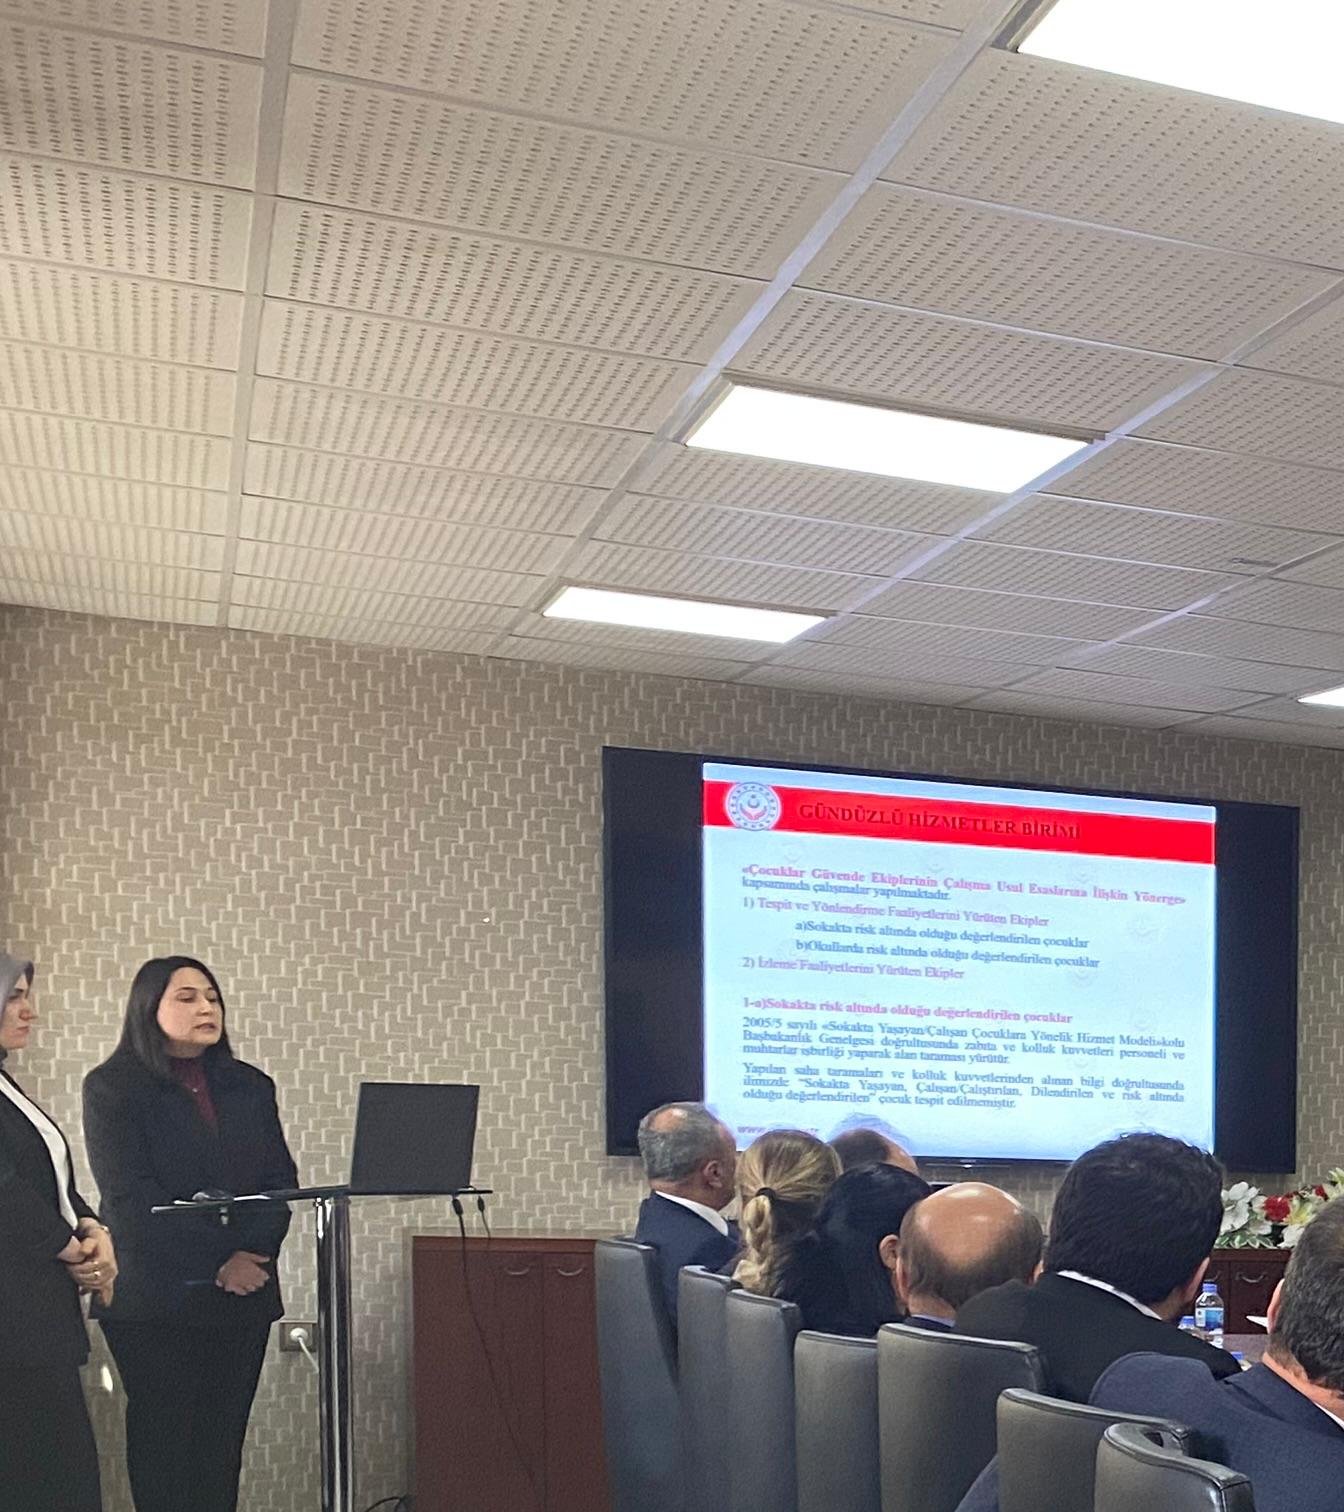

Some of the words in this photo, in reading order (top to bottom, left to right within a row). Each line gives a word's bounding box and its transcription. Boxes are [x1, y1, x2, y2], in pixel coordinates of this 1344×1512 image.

[800, 803, 904, 826] GÜNDÜZLÜ
[909, 809, 1016, 834] HİZMETLER
[1023, 818, 1080, 840] BİRİMİ
[742, 878, 810, 893] kapsamında
[813, 882, 870, 897] çalışmalar
[811, 869, 864, 882] Güvende
[871, 872, 937, 890] Ekiplerinin
[943, 877, 991, 893] Çalışma
[997, 880, 1022, 892] Usul
[1029, 882, 1087, 896] Esaslarına
[1093, 886, 1127, 901] İlişkin
[744, 897, 754, 911] 1)
[757, 898, 792, 913] Tespit
[796, 902, 808, 911] ve
[812, 901, 884, 916] Yönlendirme
[964, 910, 1006, 923] Yürüten
[1010, 913, 1049, 927] Ekipler
[855, 923, 876, 935] risk
[879, 925, 916, 937] altında
[919, 927, 958, 942] olduğu
[960, 929, 1040, 946] değerlendirilen
[1043, 934, 1089, 949] çocuklar
[742, 956, 754, 970] 2)
[758, 957, 796, 970] İzleme
[877, 963, 921, 976] Yürüten
[925, 966, 964, 980] Ekipler
[866, 944, 887, 955] risk
[890, 945, 927, 957] altında
[930, 947, 968, 962] olduğu
[971, 949, 1051, 966] değerlendirilen
[1054, 954, 1099, 969] çocuklar
[820, 1001, 842, 1012] risk
[846, 1002, 886, 1014] altında
[890, 1004, 930, 1018] olduğu
[934, 1006, 1020, 1022] değerlendirilen
[1023, 1010, 1072, 1025] çocuklar
[743, 1018, 781, 1032] 2005/5
[787, 1019, 816, 1033] sayılı
[971, 1028, 1025, 1042] Çocuklara
[1032, 1030, 1072, 1042] Yönelik
[1077, 1032, 1114, 1043] Hizmet
[743, 1030, 811, 1045] Başbakanlık
[819, 1034, 874, 1048] Genelgesi
[881, 1036, 958, 1051] doğrultusunda
[965, 1040, 996, 1050] zabıta
[1003, 1043, 1015, 1051] ve
[1022, 1042, 1054, 1053] kolluk
[1062, 1044, 1113, 1055] kuvvetleri
[1119, 1046, 1165, 1060] personeli
[1173, 1050, 1184, 1058] ve
[847, 1048, 892, 1061] yaparak
[894, 1050, 917, 1059] alan
[920, 1051, 965, 1061] taraması
[744, 1063, 786, 1077] Yapılan
[794, 1065, 819, 1075] saha
[827, 1066, 883, 1078] taramaları
[891, 1070, 903, 1078] ve
[912, 1070, 946, 1080] kolluk
[955, 1071, 1033, 1083] kuvvetlerinden
[1041, 1075, 1072, 1085] alınan
[1080, 1076, 1103, 1088] bilgi
[1111, 1077, 1183, 1091] doğrultusunda
[742, 1089, 782, 1102] olduğu
[878, 1094, 911, 1106] çocuk
[915, 1095, 943, 1107] tespit
[1031, 1087, 1093, 1098] Dilendirilen
[1102, 1090, 1114, 1099] ve
[1122, 1090, 1141, 1100] risk
[1150, 1091, 1183, 1101] altında
